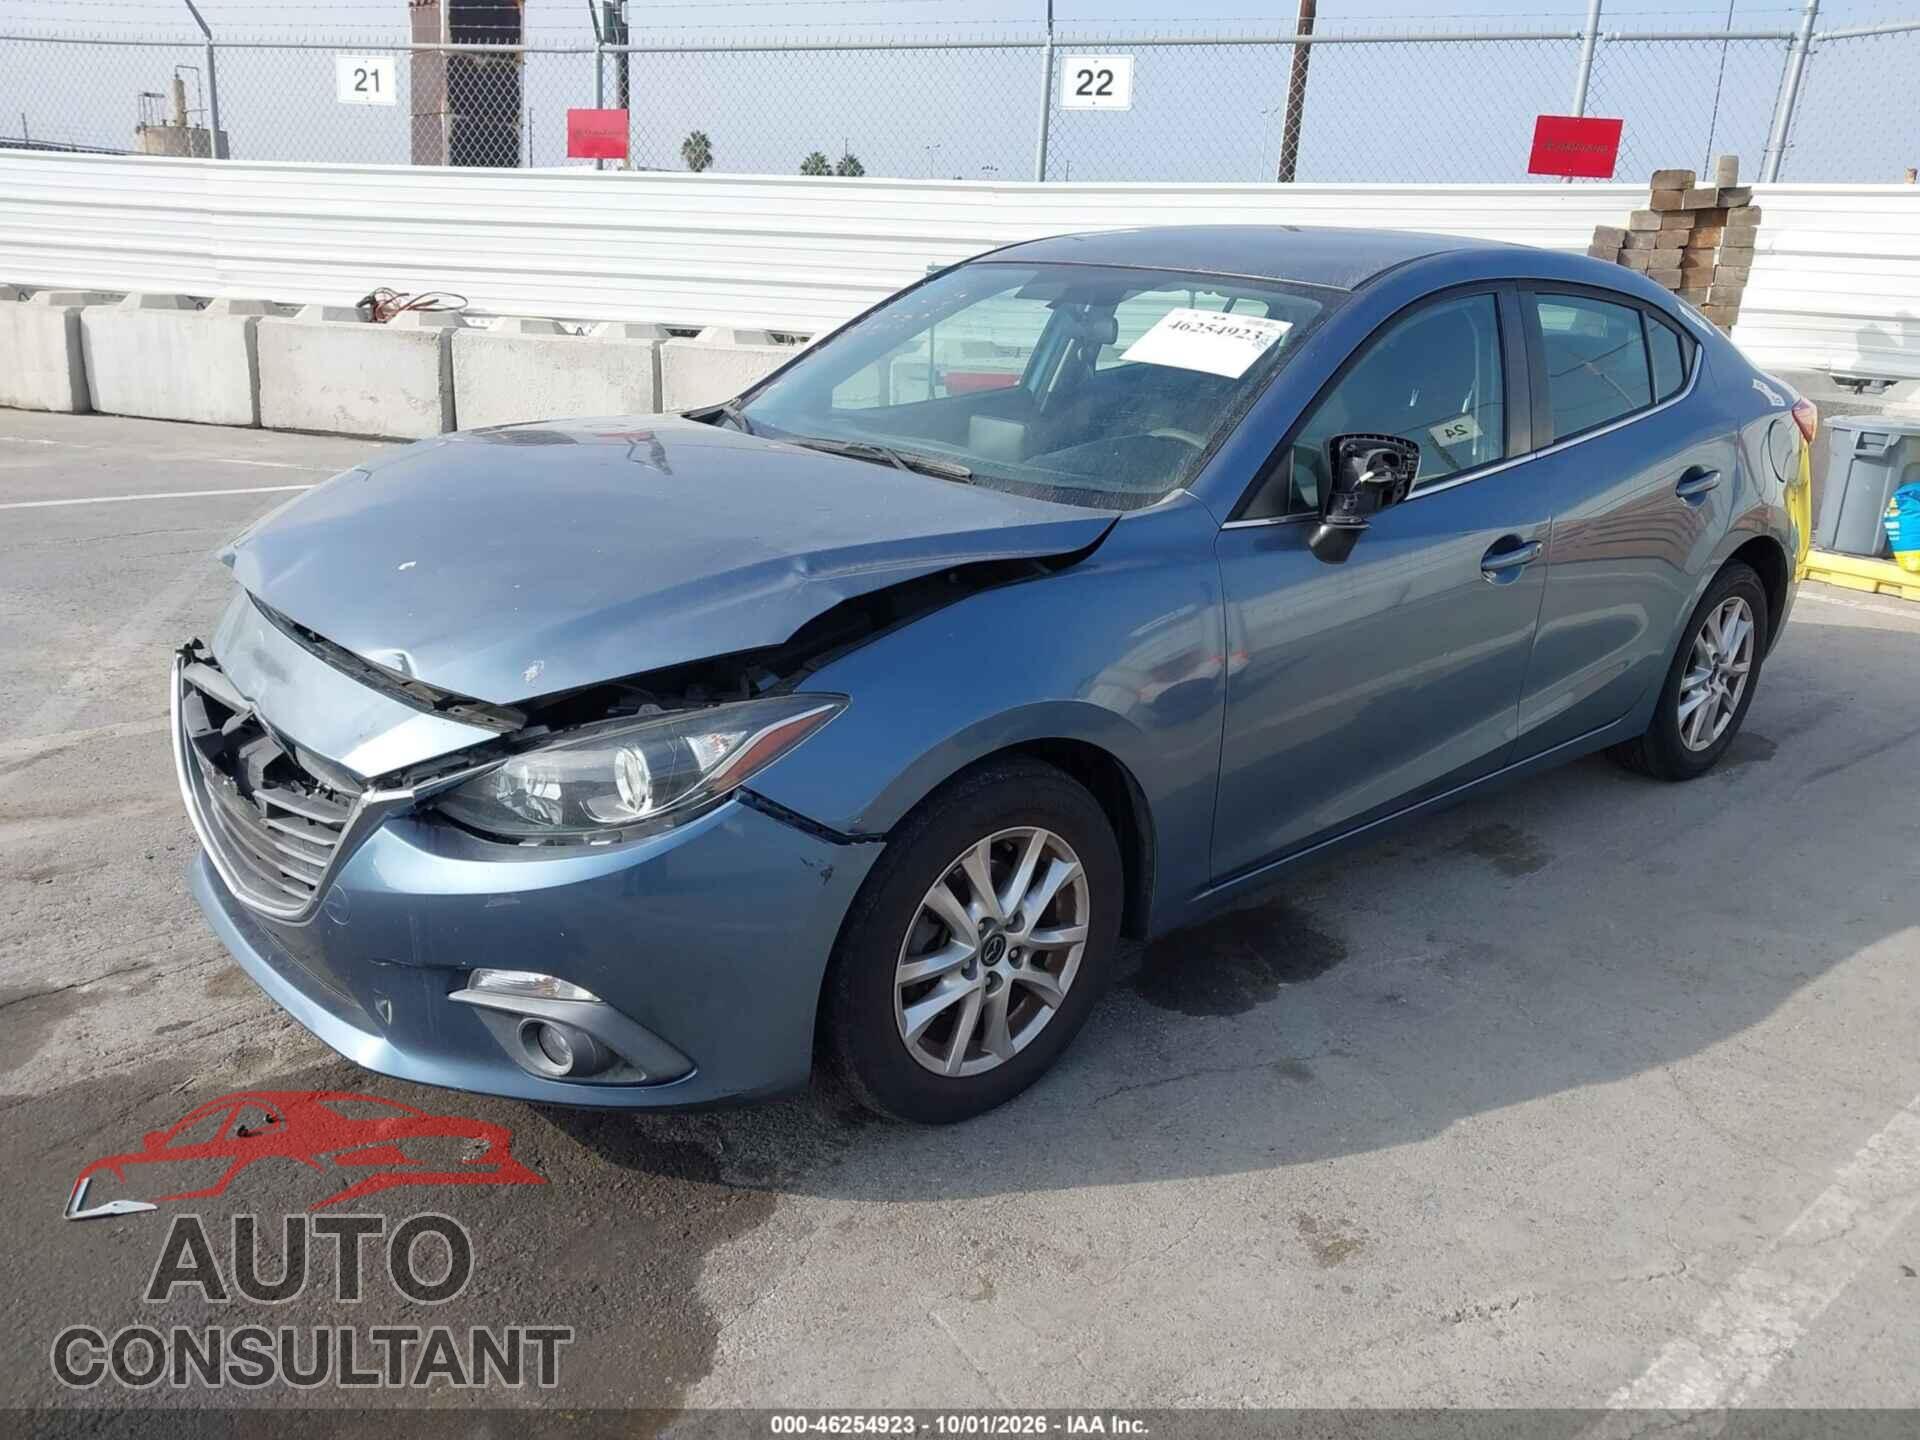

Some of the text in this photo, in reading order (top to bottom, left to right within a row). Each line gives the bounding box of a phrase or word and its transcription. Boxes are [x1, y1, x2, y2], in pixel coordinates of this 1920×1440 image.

[353, 67, 379, 92] 21
[1076, 68, 1113, 95] 22
[1167, 319, 1264, 341] 46254923
